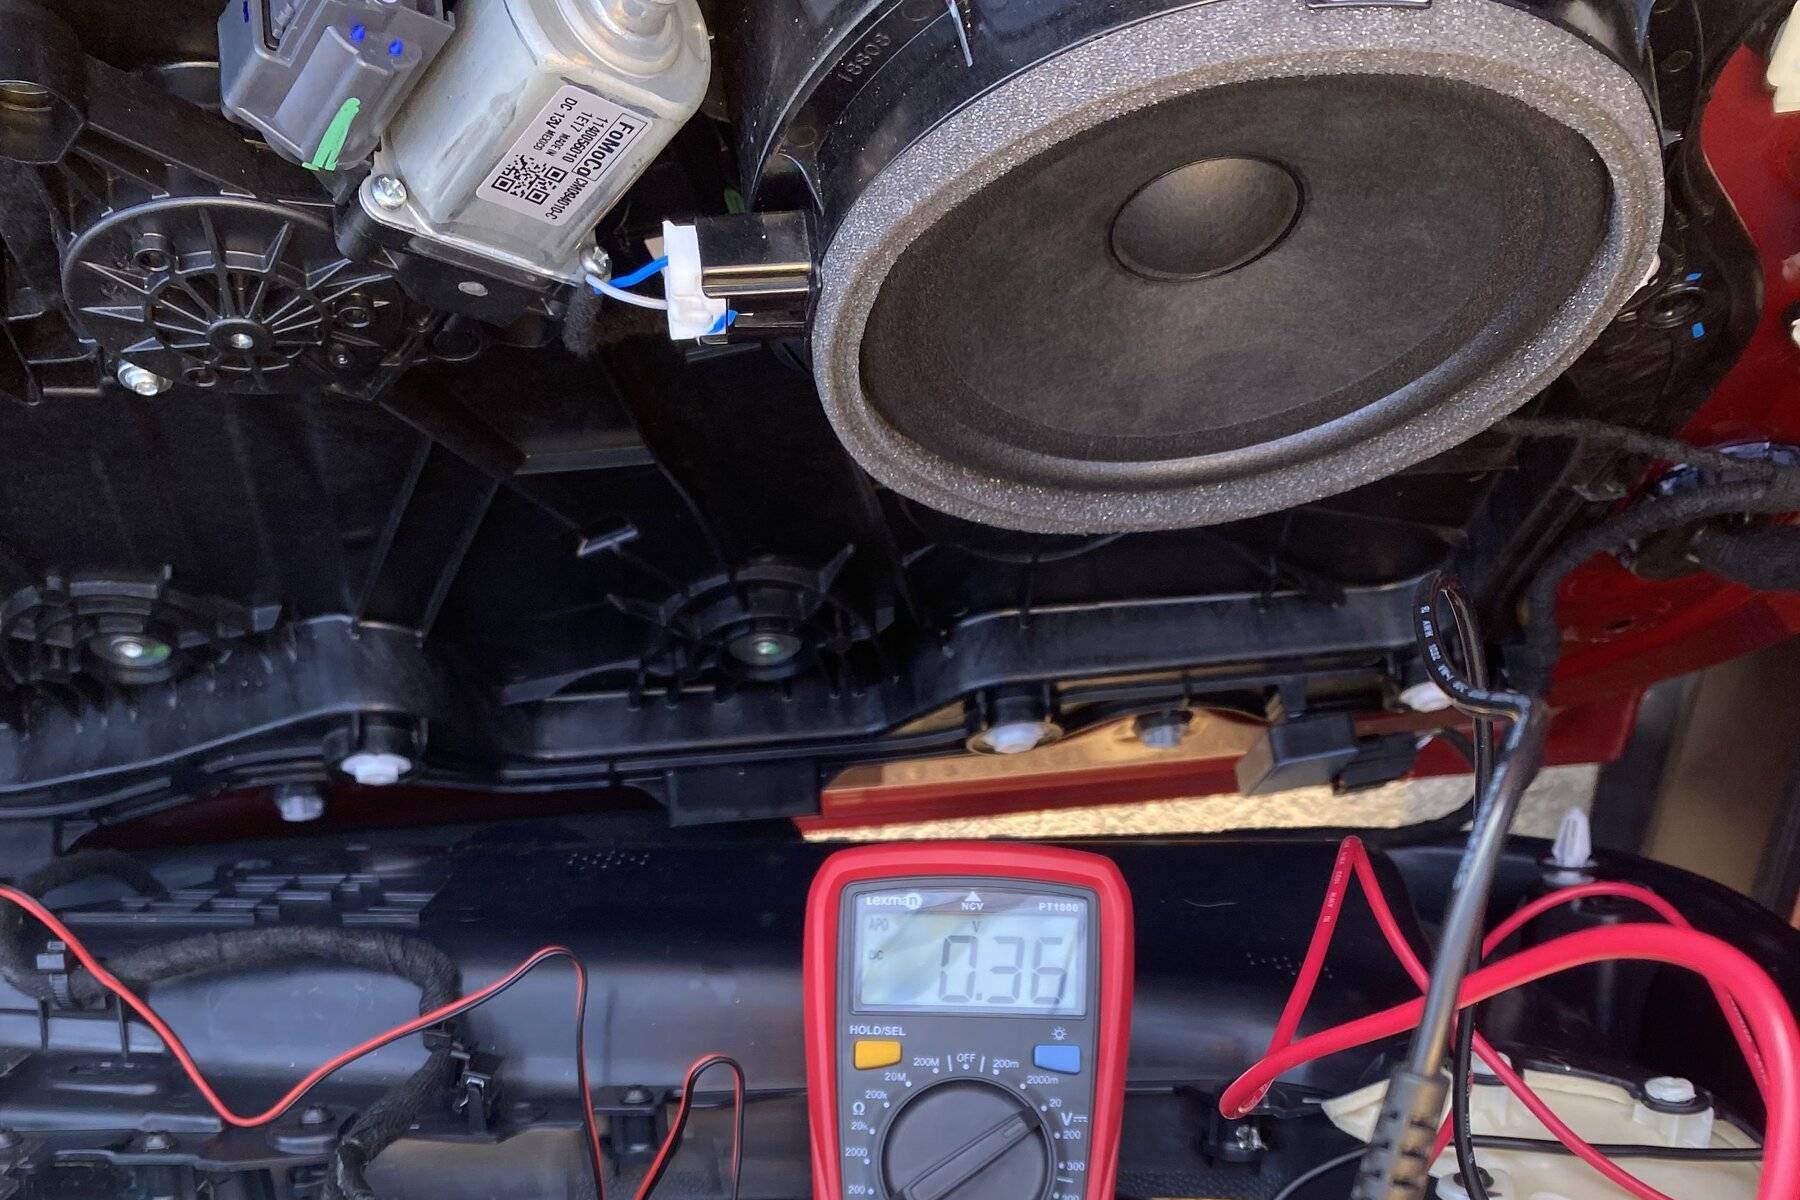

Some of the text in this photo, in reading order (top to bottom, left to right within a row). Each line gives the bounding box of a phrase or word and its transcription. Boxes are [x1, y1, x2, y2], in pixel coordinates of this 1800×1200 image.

[545, 97, 578, 129] DC 13V
[533, 130, 556, 151] MEXICO
[554, 133, 571, 151] MADE
[577, 121, 635, 179] FoMoCo
[961, 902, 984, 911] NCV
[938, 935, 1068, 1004] 0.36
[849, 1025, 907, 1036] HOLD/SEL
[913, 1057, 940, 1067] 200M
[956, 1053, 975, 1063] OFF
[992, 1059, 1020, 1069] 200m
[884, 1072, 907, 1081] 20M
[1026, 1075, 1059, 1085] 2000m
[1049, 1099, 1061, 1107] 20
[1063, 1131, 1081, 1139] 200
[1067, 1162, 1085, 1171] 300
[848, 1184, 866, 1194] 200
